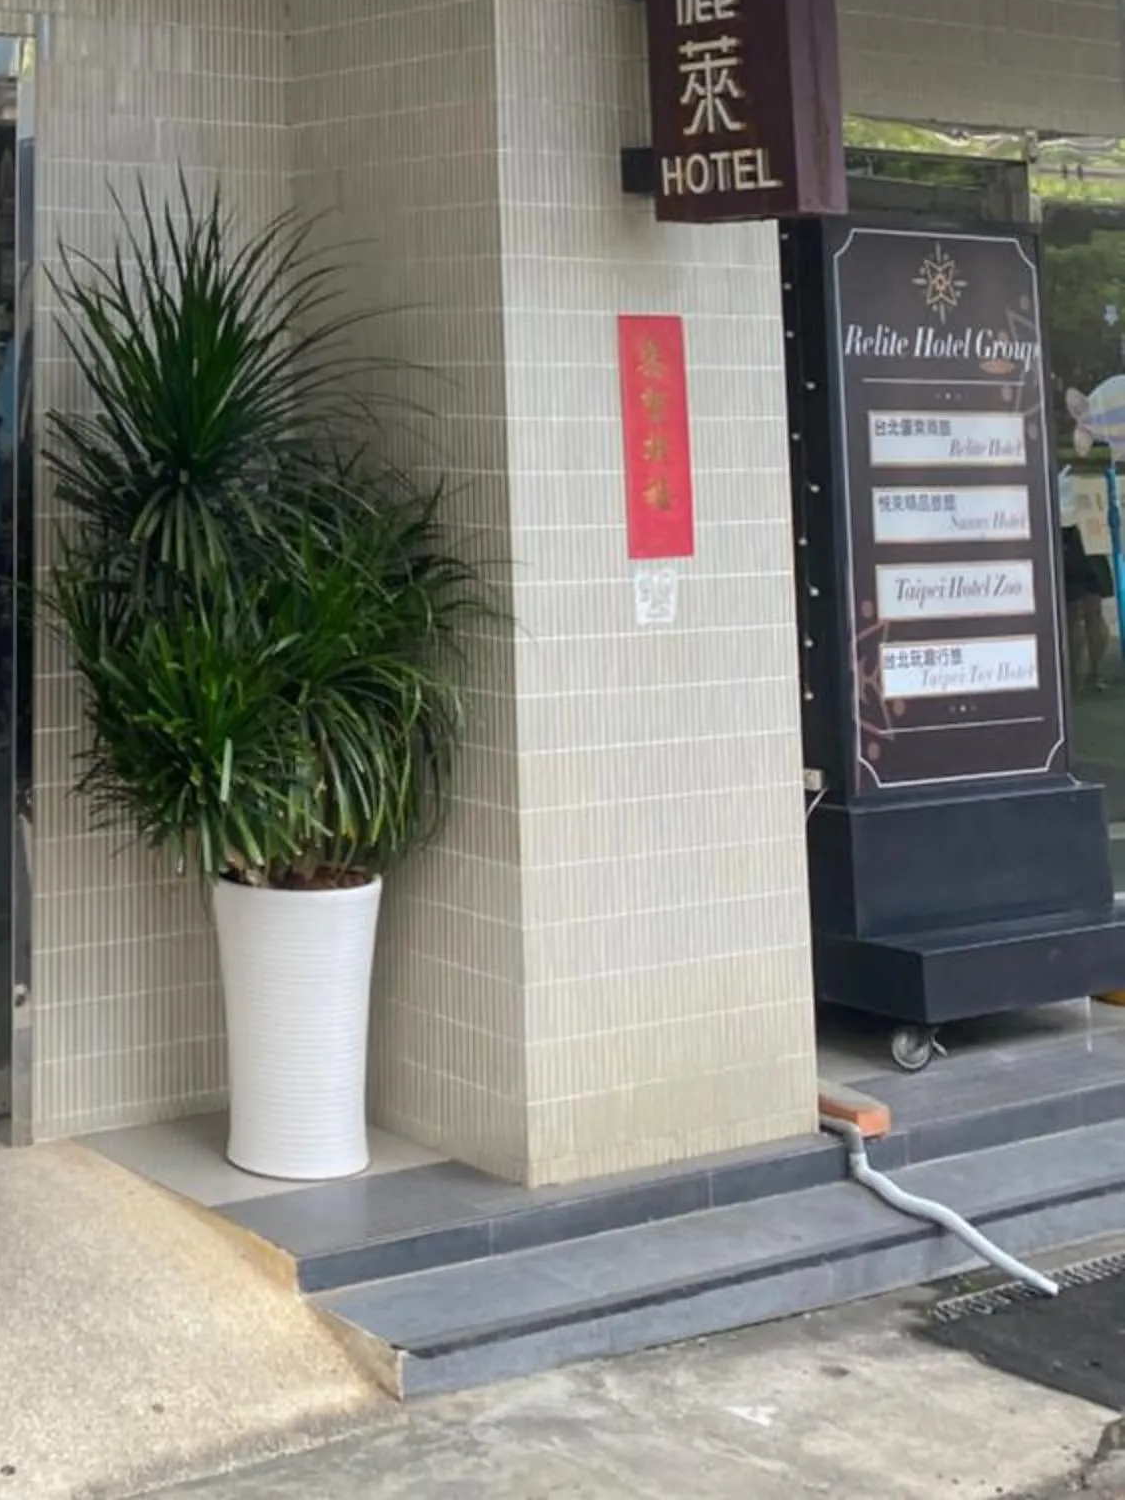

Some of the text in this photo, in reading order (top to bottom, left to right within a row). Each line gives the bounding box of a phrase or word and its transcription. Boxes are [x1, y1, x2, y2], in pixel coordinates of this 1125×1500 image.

[661, 147, 783, 197] HOTEL
[845, 323, 909, 358] Relite
[913, 326, 972, 359] Hotel
[895, 576, 947, 609] Taipei
[948, 573, 991, 599] Hotel
